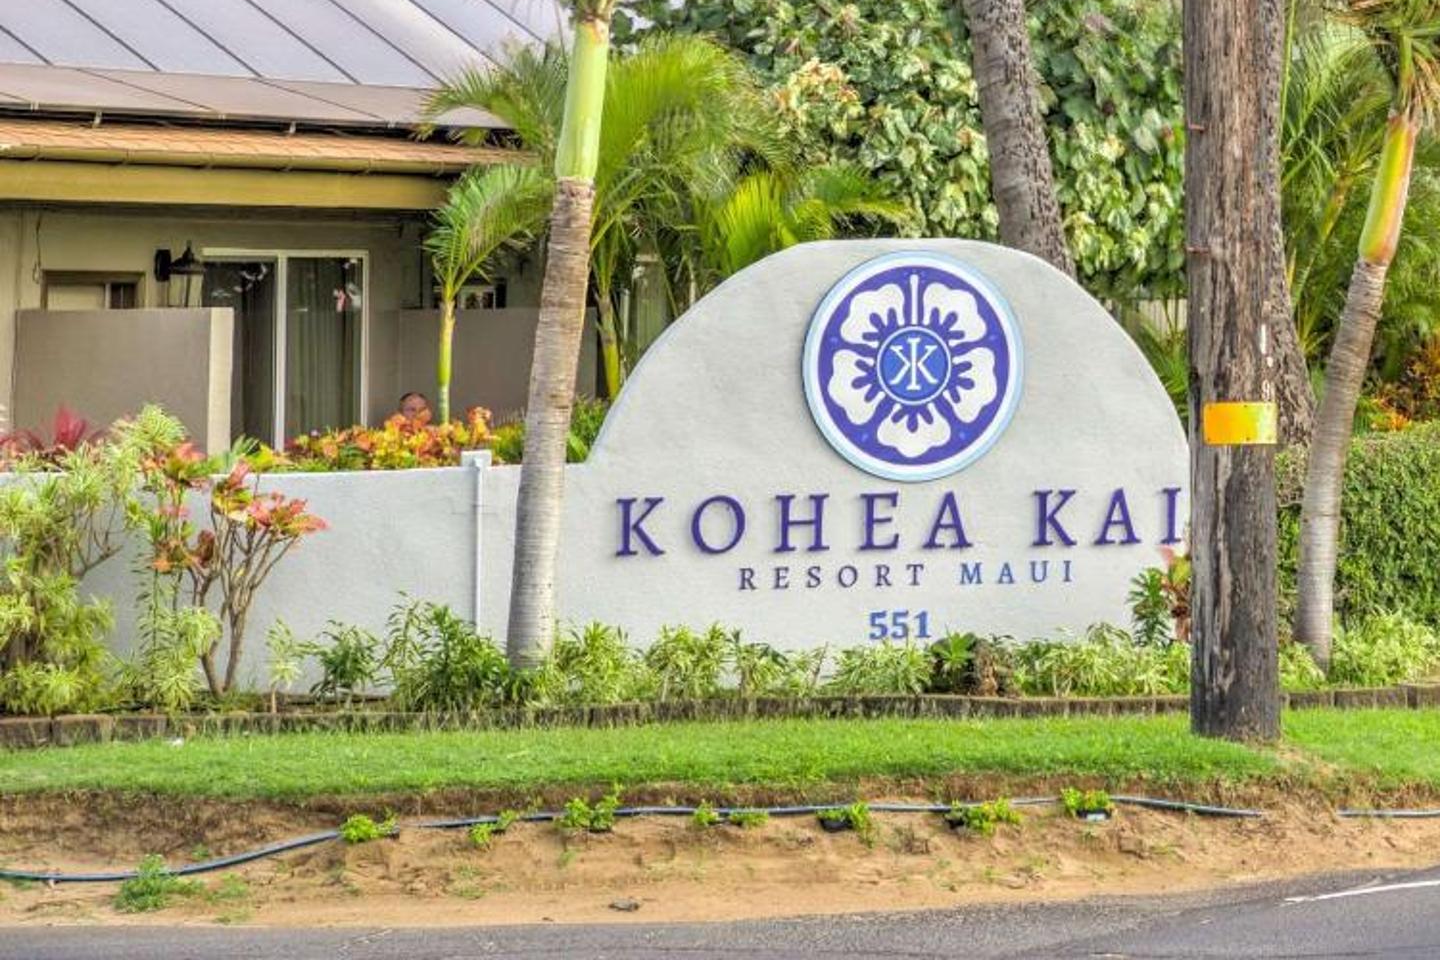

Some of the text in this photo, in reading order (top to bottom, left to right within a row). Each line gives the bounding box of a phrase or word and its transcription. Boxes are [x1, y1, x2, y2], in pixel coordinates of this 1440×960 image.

[614, 486, 1182, 558] KOHEA KAI
[738, 560, 1073, 590] RESORT MAUI
[868, 610, 932, 641] 551
